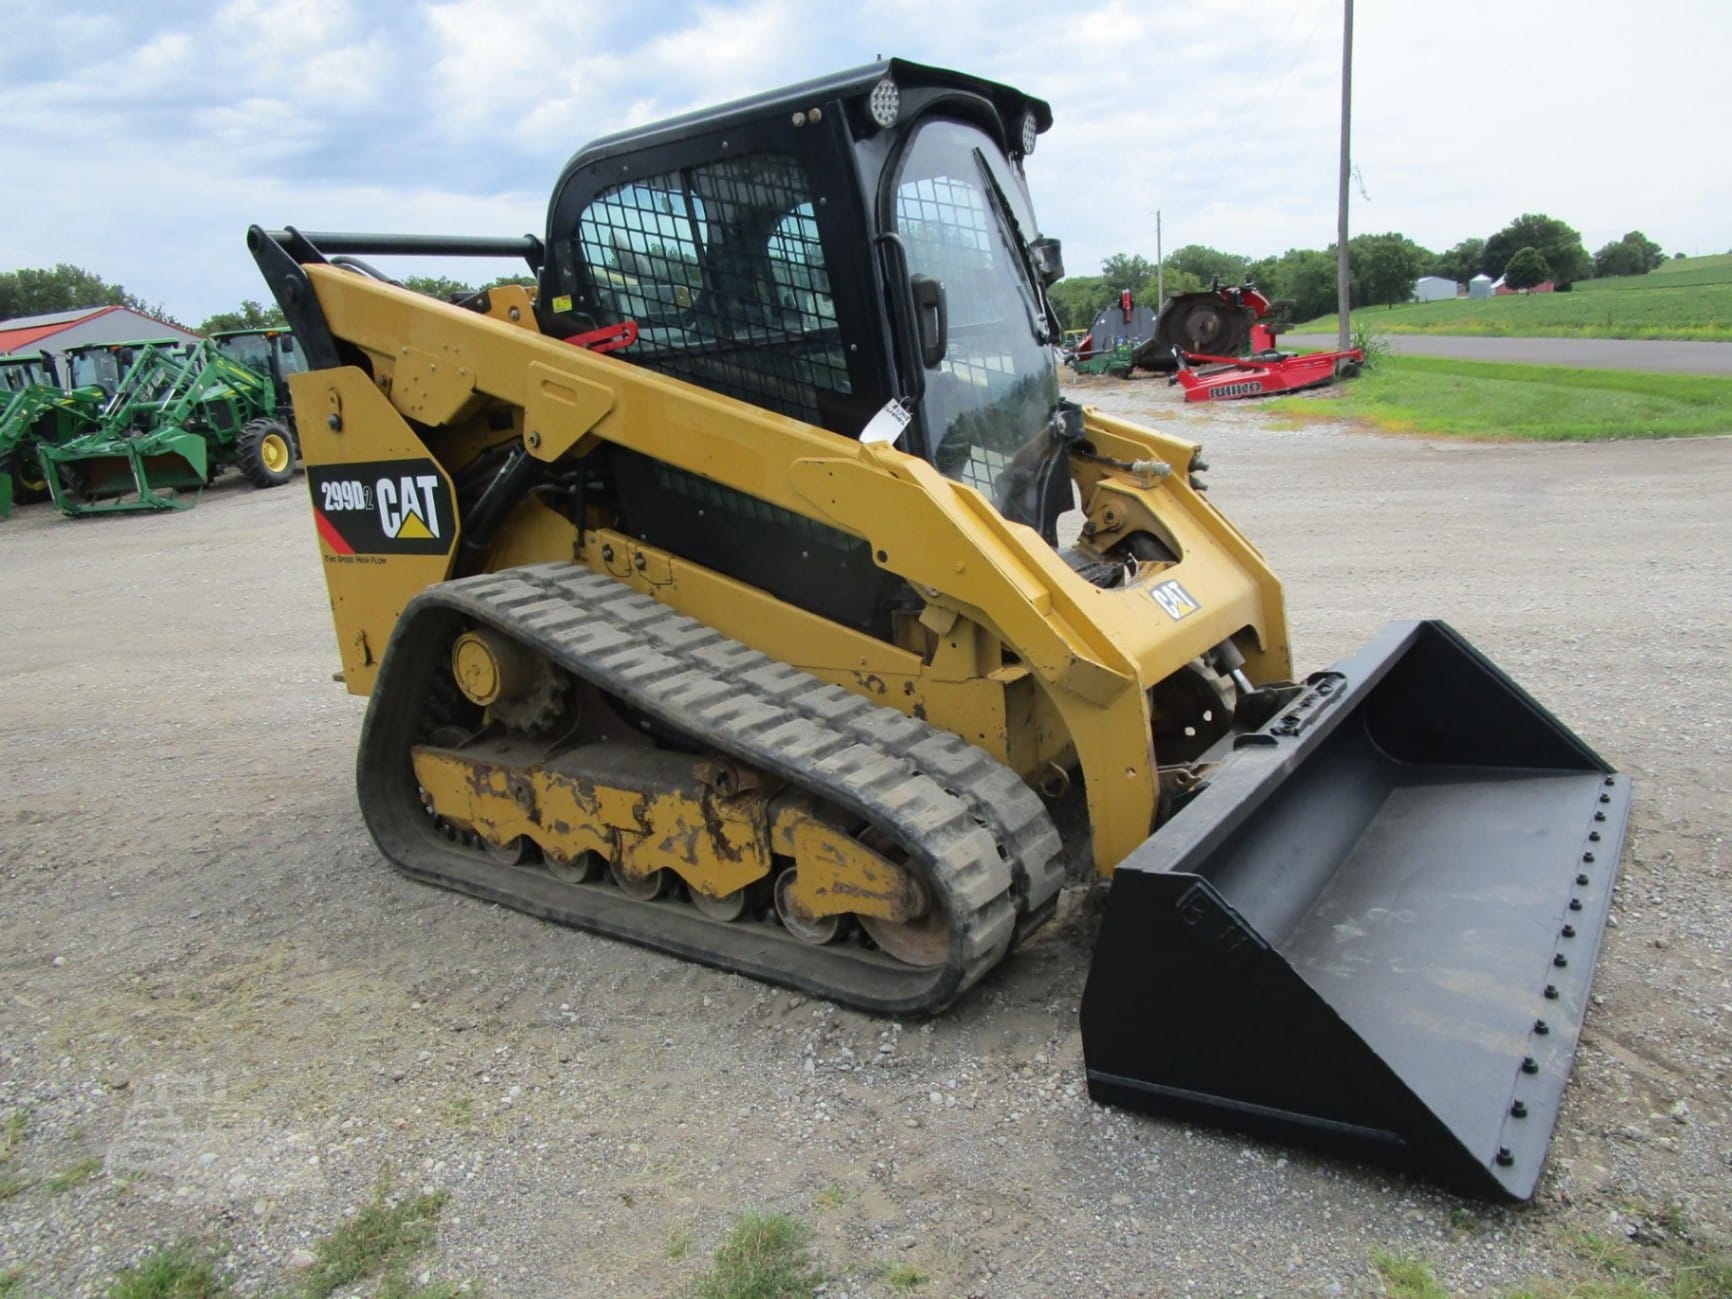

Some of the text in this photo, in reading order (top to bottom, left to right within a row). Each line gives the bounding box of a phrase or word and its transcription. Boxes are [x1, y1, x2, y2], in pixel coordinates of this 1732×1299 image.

[1210, 382, 1262, 398] RHINO
[376, 475, 440, 538] CAT
[1152, 581, 1198, 619] CAT
